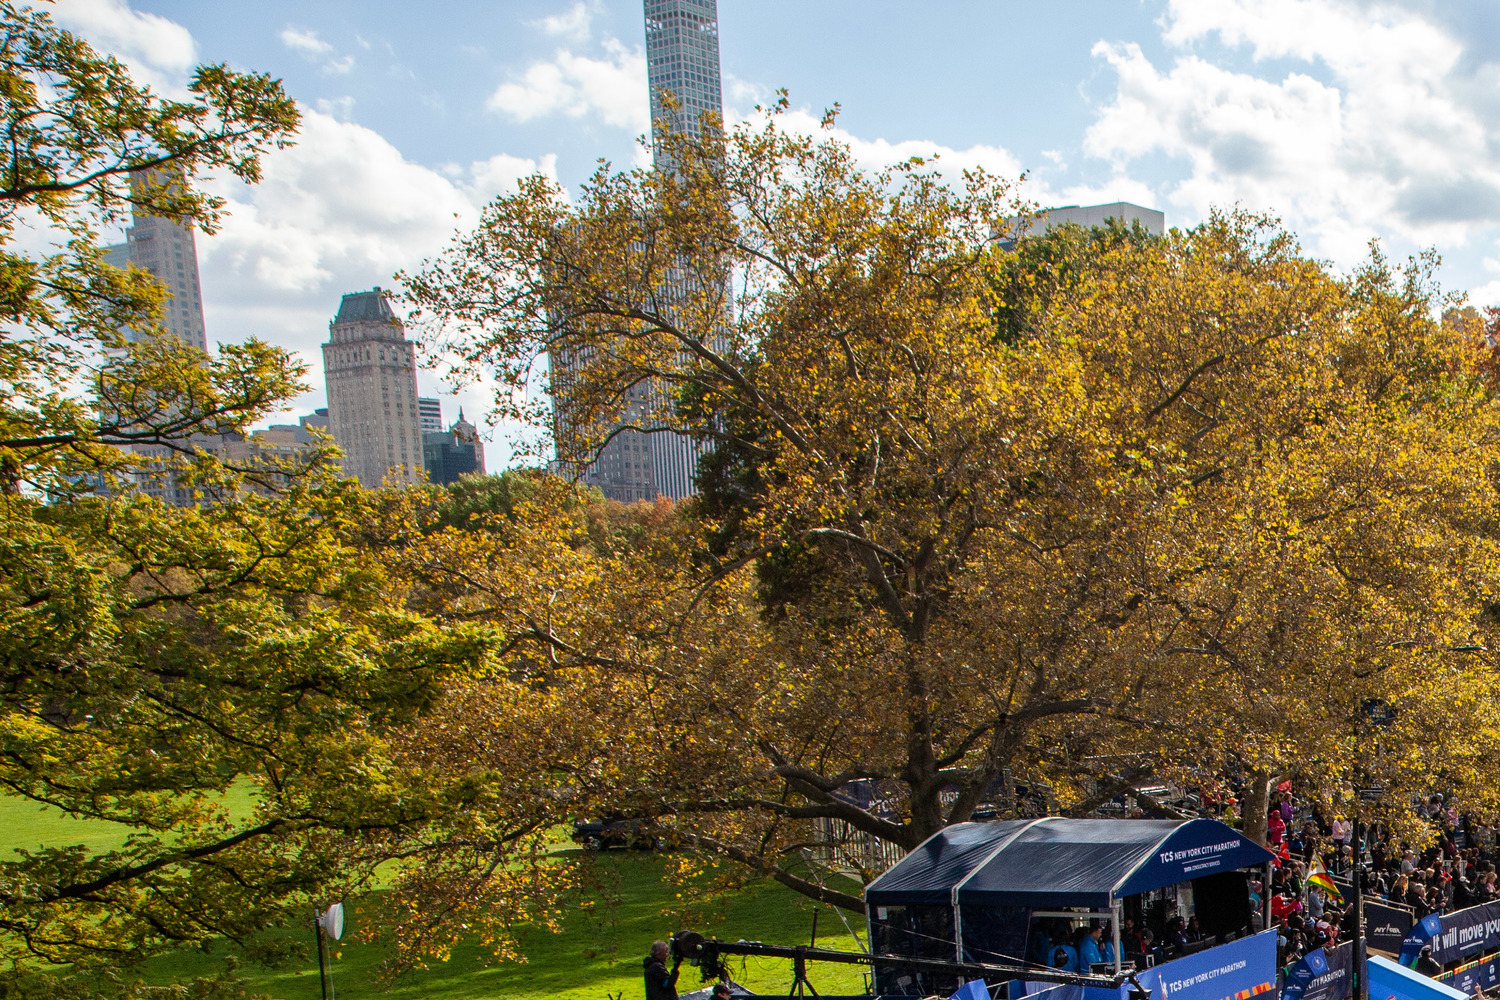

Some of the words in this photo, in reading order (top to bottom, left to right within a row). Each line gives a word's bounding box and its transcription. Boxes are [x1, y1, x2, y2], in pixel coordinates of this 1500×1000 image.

[1160, 851, 1174, 864] TCS
[1174, 850, 1187, 860] NEW
[1187, 848, 1201, 857] YORK
[1201, 845, 1213, 855] CITY
[1213, 840, 1240, 852] MARATHON
[1432, 933, 1440, 953] It
[1442, 926, 1458, 950] will
[1459, 923, 1484, 944] move
[1169, 980, 1182, 993] TCS
[1182, 977, 1195, 989] NEW
[1195, 972, 1208, 984] YORK
[1208, 968, 1220, 979] CITY
[1220, 960, 1247, 975] MARATHON
[1319, 967, 1346, 985] MARATHON
